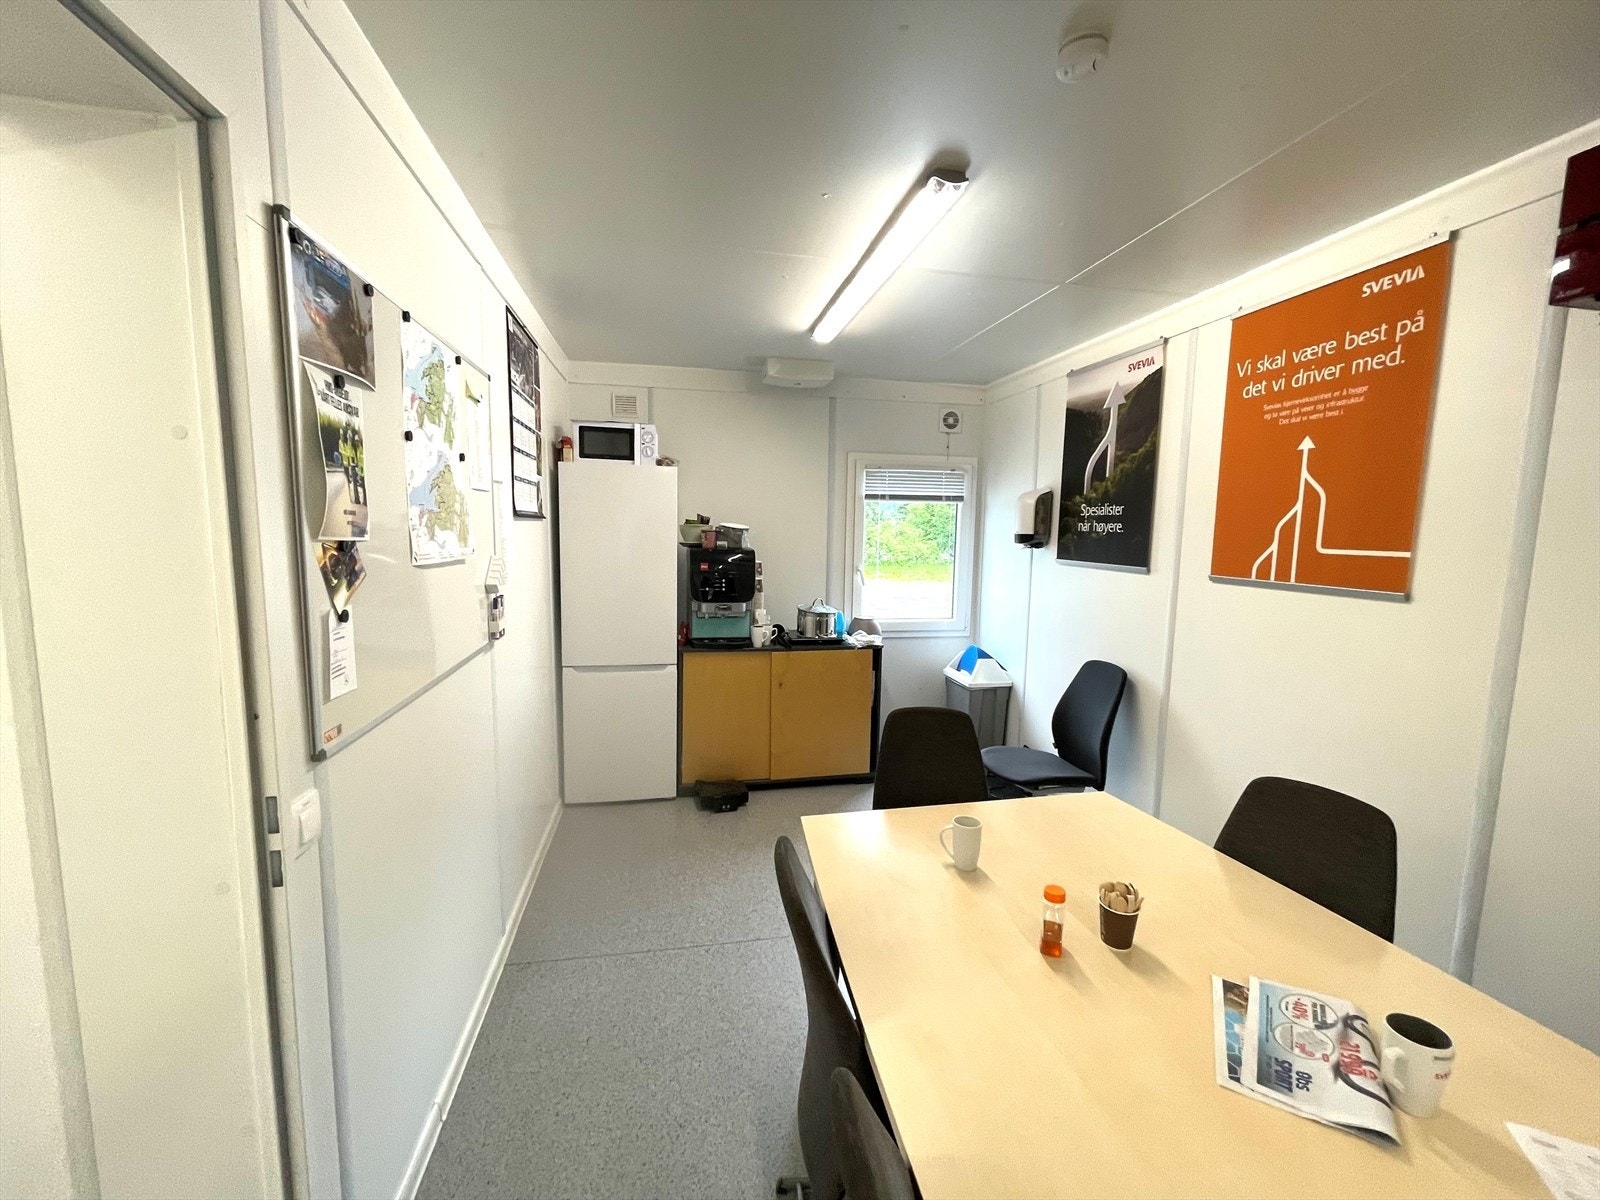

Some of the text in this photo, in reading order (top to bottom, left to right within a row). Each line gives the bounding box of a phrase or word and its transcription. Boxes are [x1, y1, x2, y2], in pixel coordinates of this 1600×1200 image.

[1361, 265, 1425, 298] SVEVIA
[1236, 309, 1425, 378] Vi skal være best på
[1128, 356, 1155, 372] SVEVIA
[1242, 344, 1406, 399] det vi driver med.
[1333, 390, 1341, 398] er
[1348, 385, 1369, 395] bygge
[1291, 407, 1300, 416] på
[1325, 410, 1340, 418] best
[1080, 502, 1125, 519] Spesialister
[1077, 520, 1124, 535] når høyere.
[1274, 1056, 1294, 1094] SPORT
